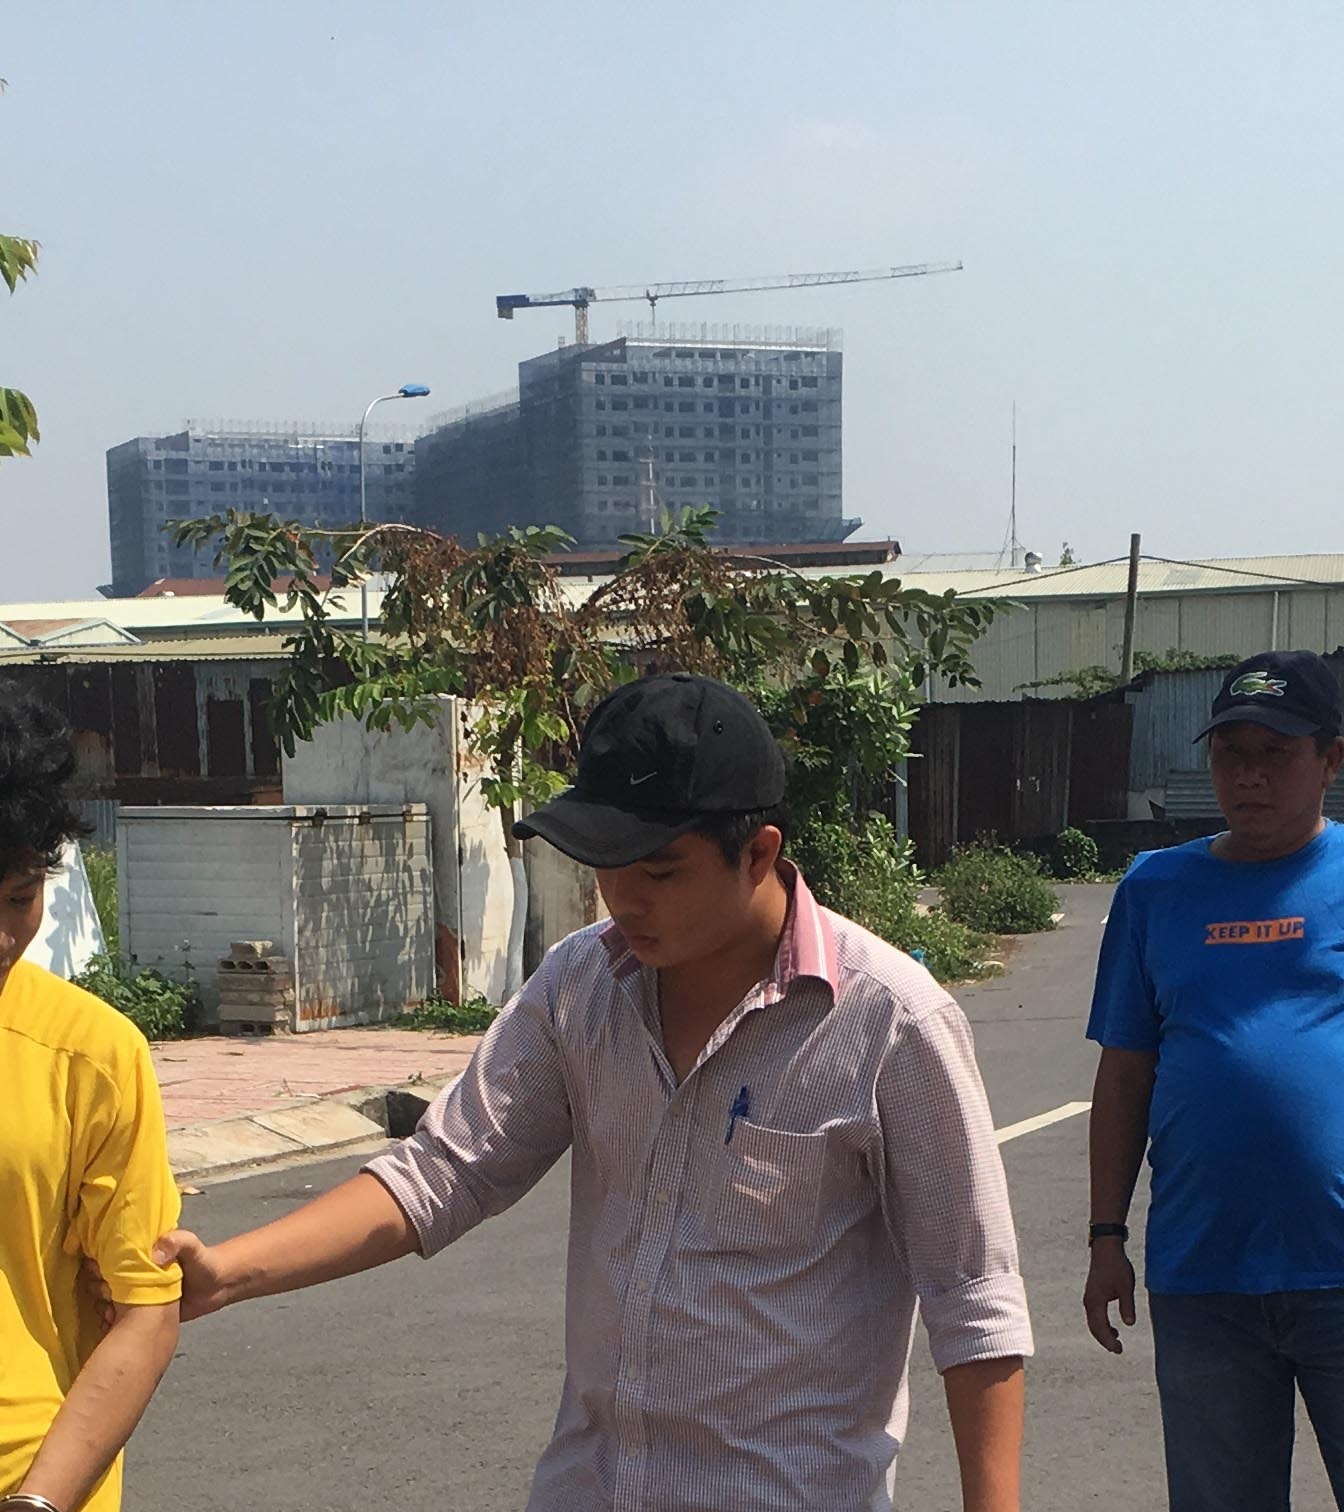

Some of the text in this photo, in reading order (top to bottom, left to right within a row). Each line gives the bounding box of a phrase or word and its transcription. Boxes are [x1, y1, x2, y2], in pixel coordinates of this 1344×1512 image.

[1205, 920, 1304, 940] KEEP IT UP
